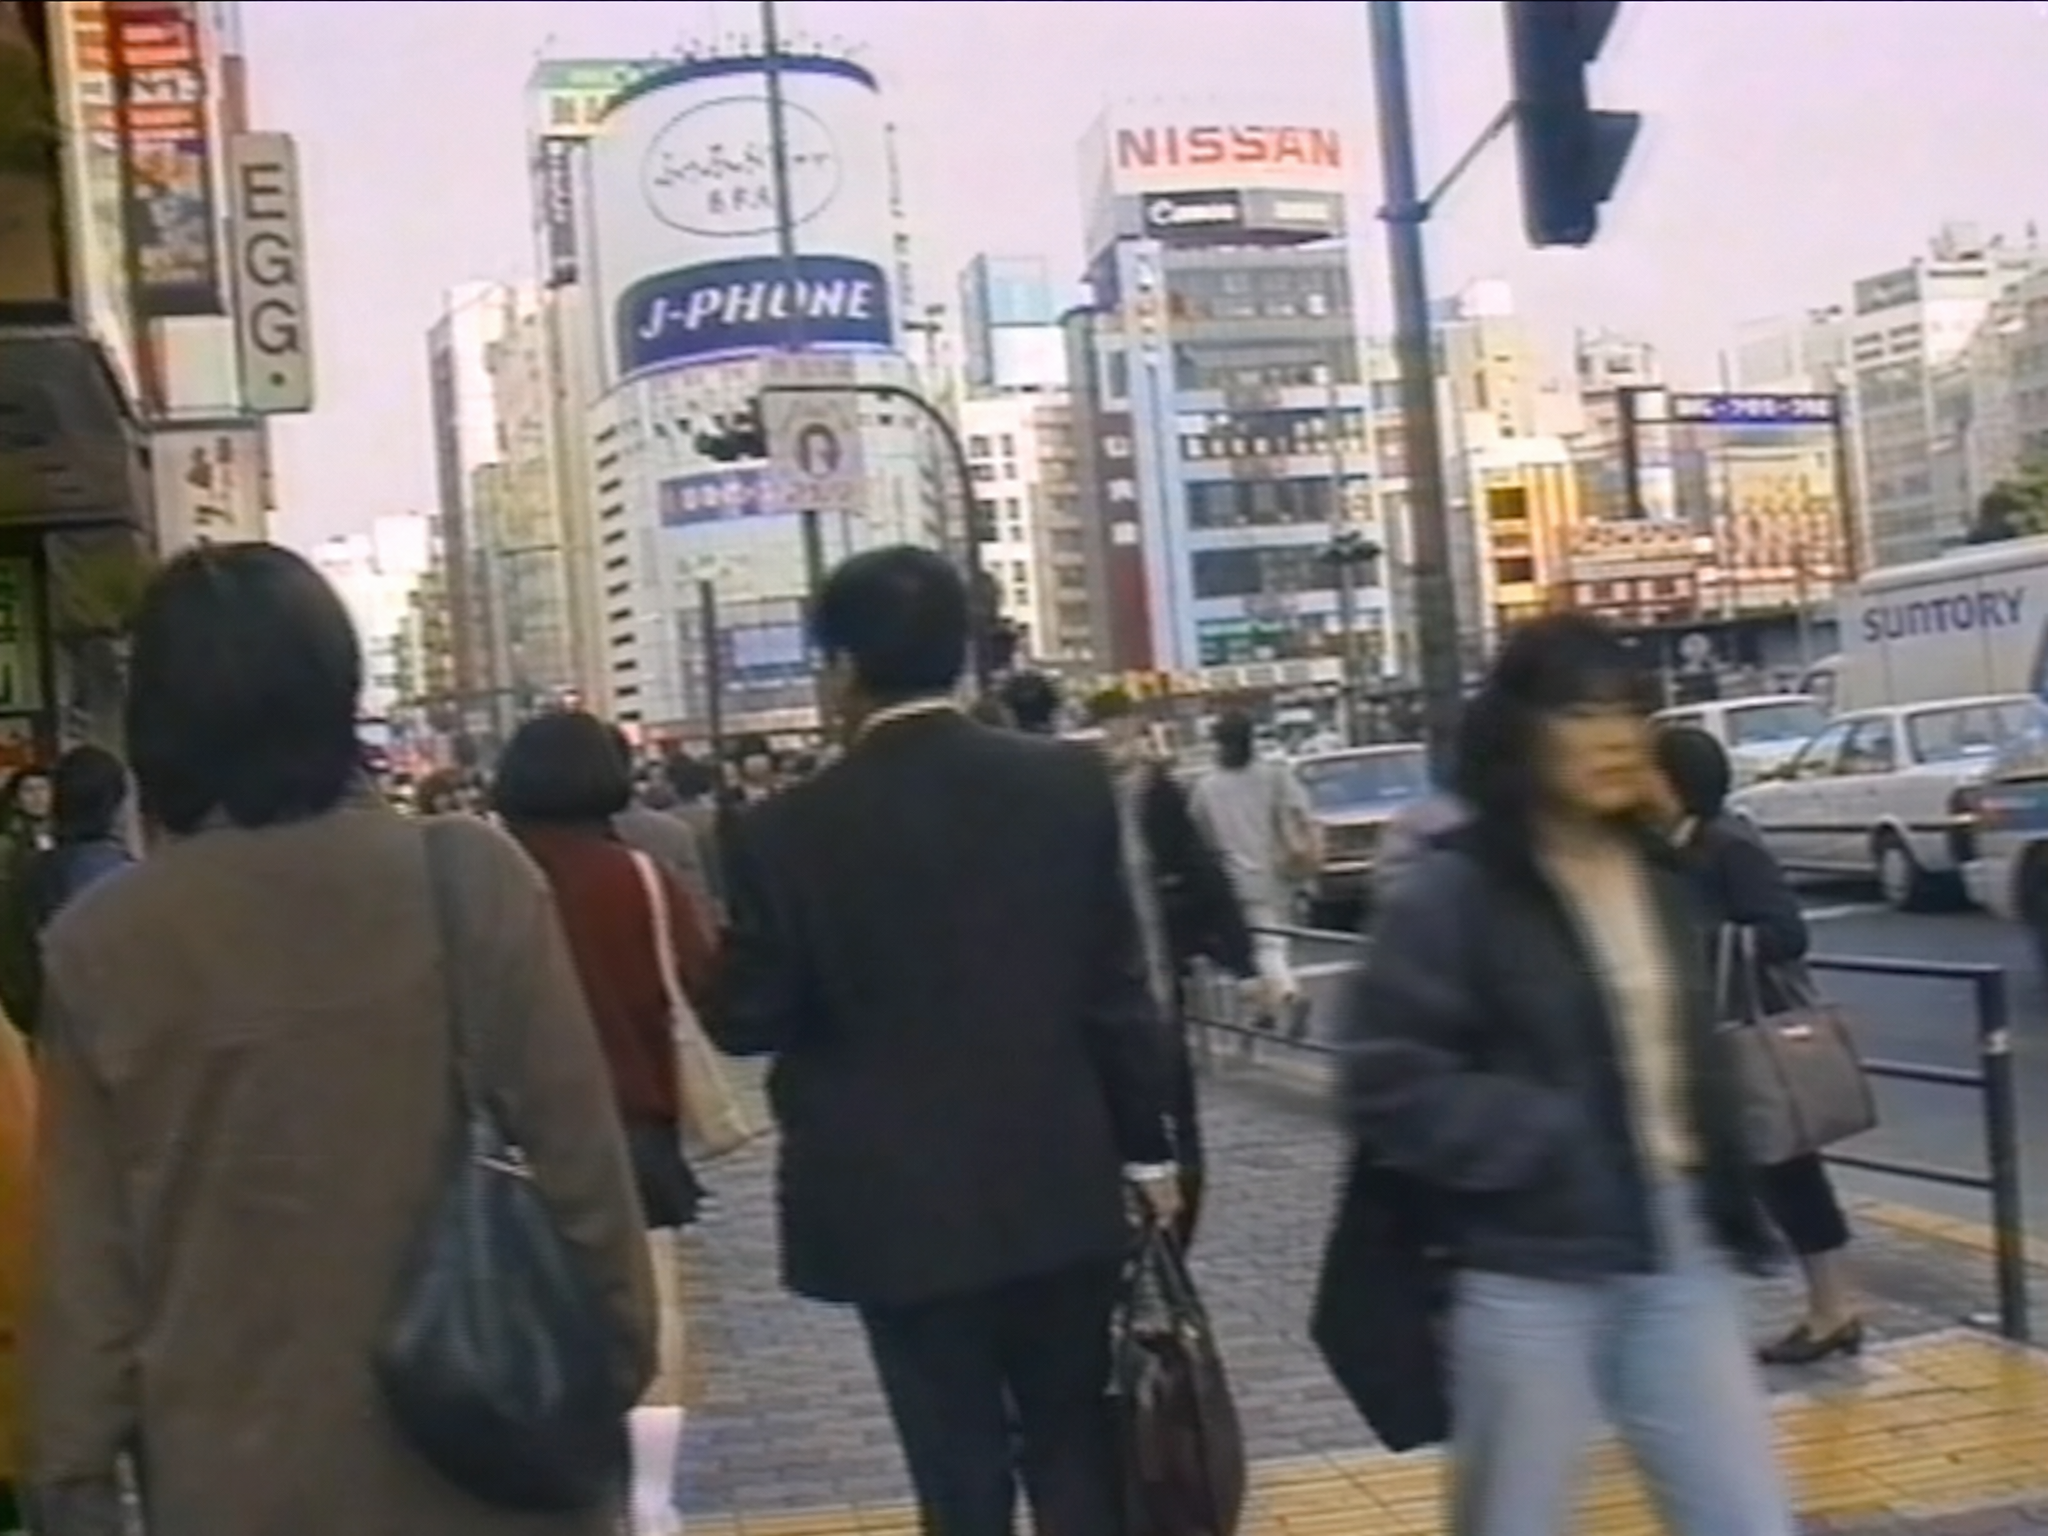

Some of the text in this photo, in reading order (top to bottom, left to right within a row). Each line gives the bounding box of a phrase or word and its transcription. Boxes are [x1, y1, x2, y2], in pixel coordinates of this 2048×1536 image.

[1116, 124, 1341, 168] NISSAN
[638, 279, 873, 340] J-PHONE
[1863, 587, 2025, 643] SUNTORY
